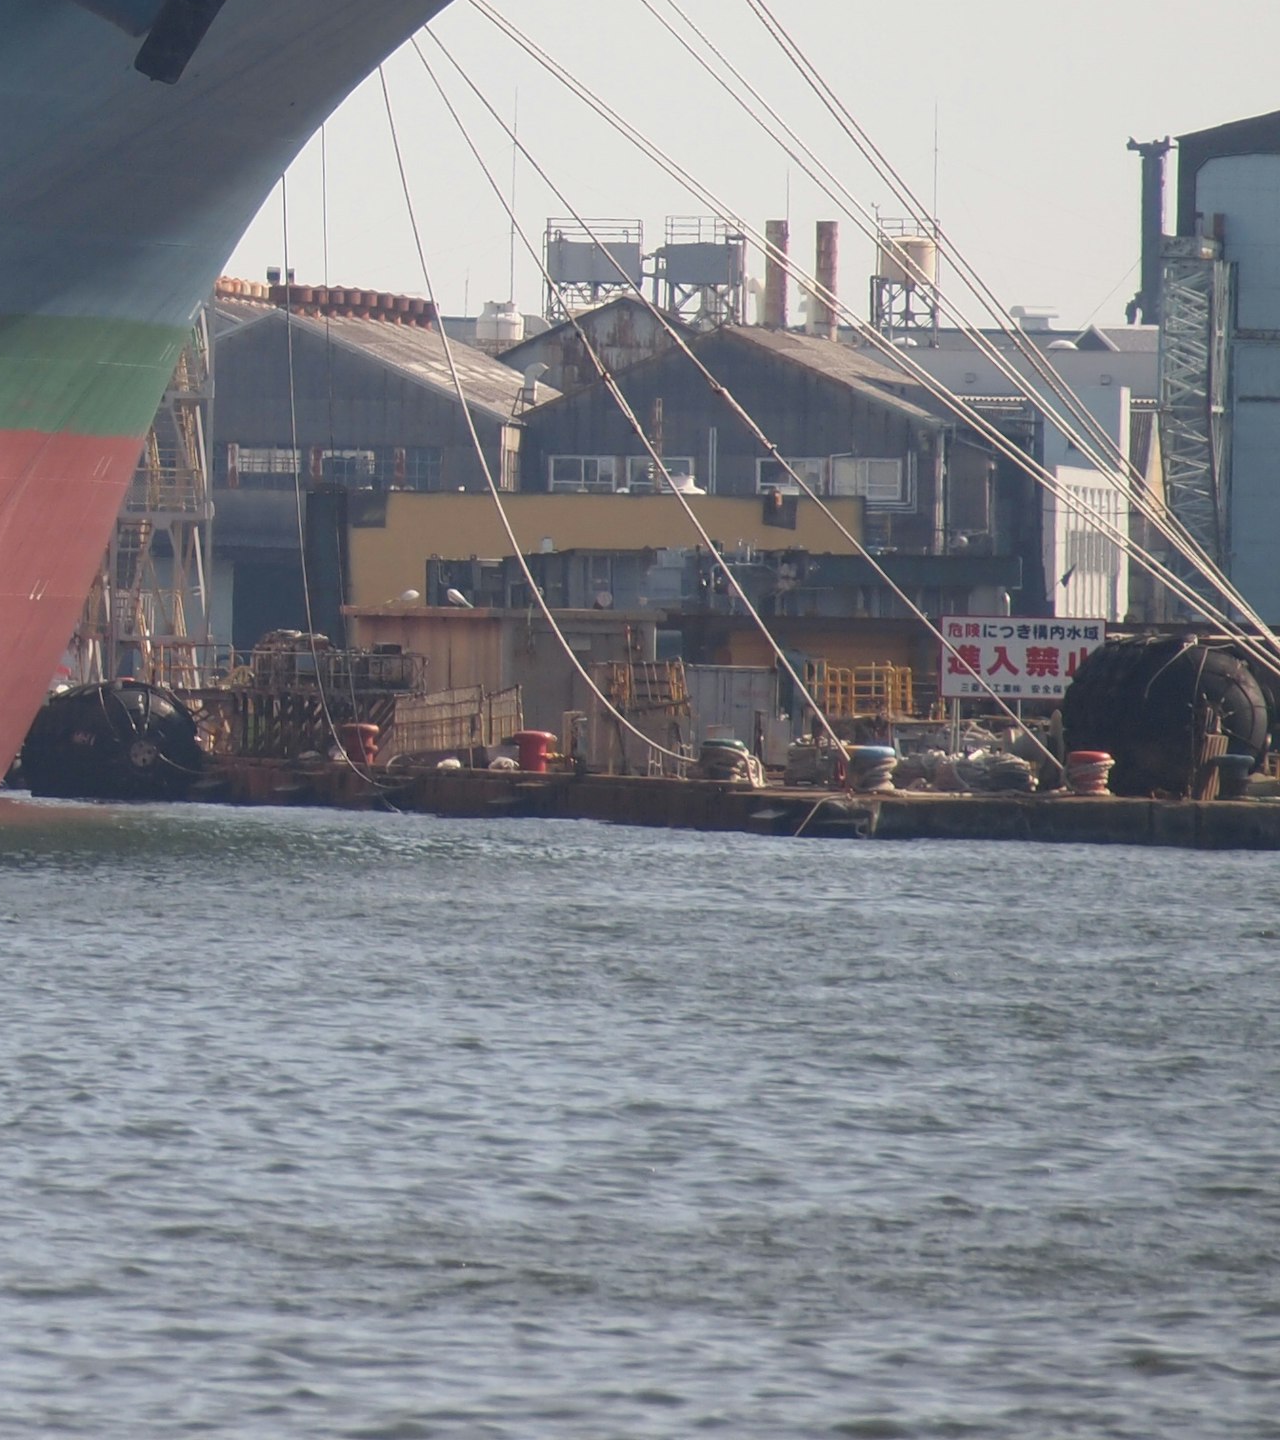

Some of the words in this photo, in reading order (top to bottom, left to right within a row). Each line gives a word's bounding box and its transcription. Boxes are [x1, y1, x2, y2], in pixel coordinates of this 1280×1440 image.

[947, 622, 1100, 641] 危険につき構内水域
